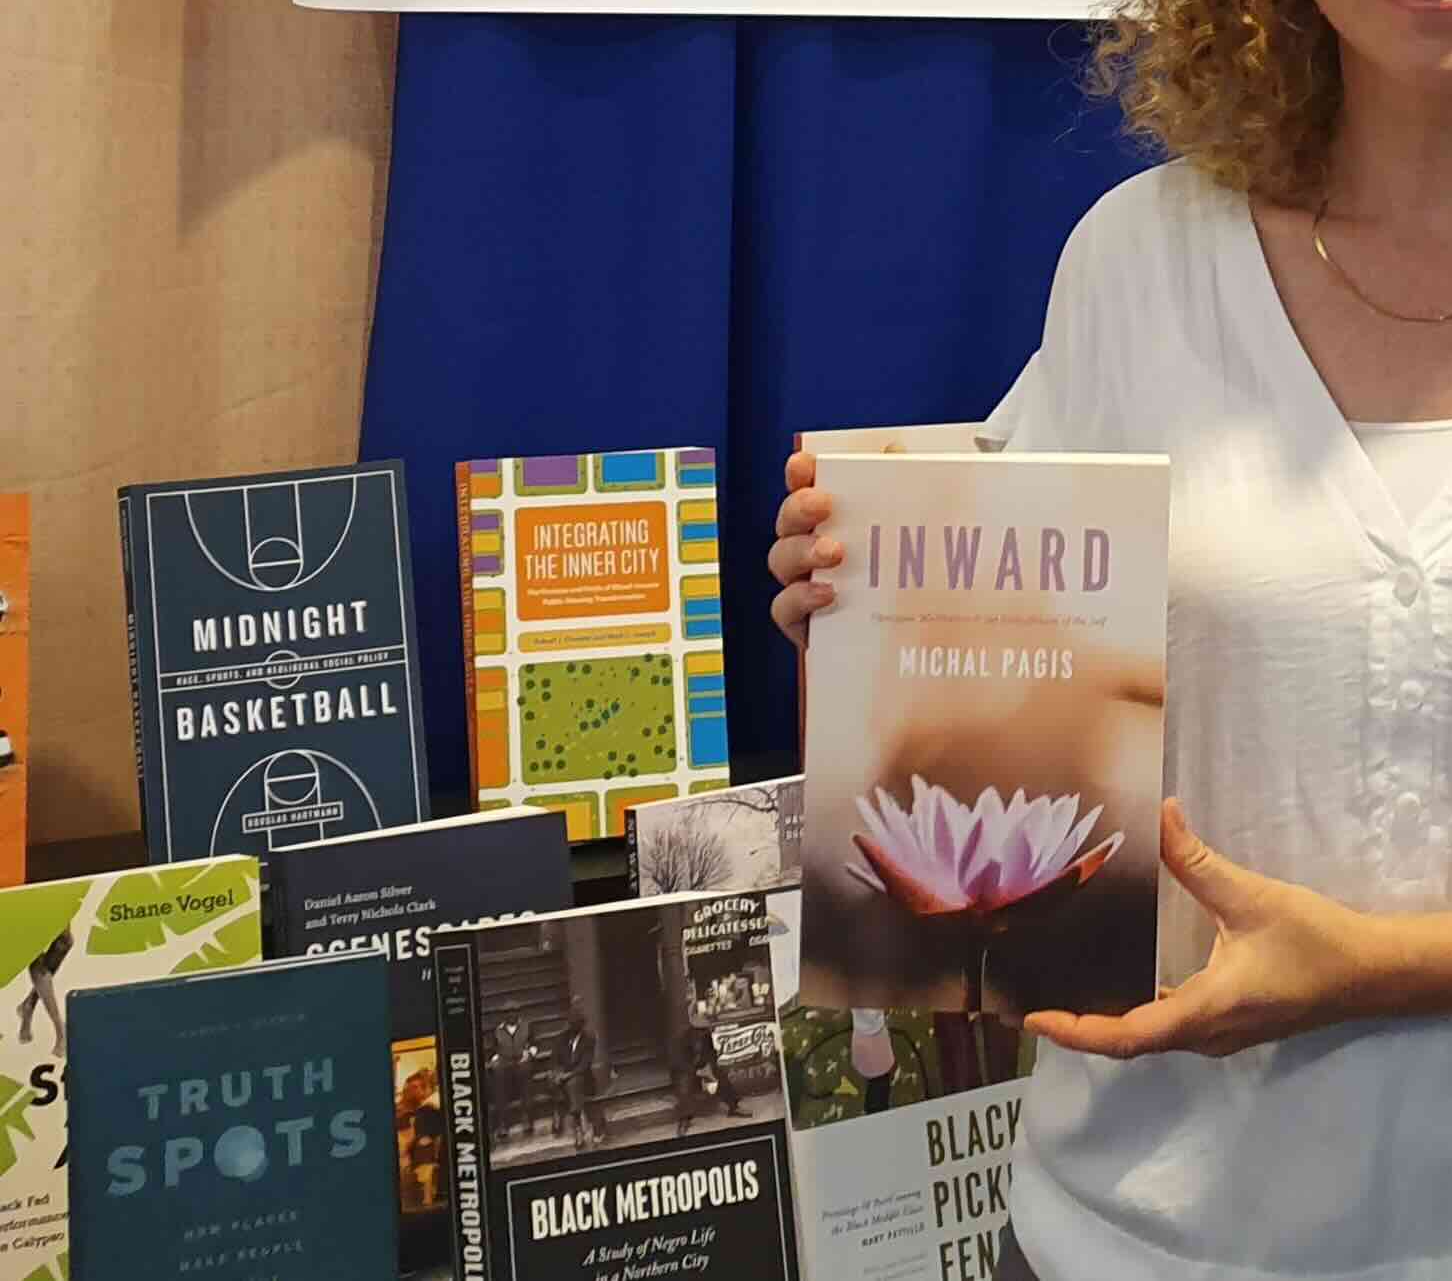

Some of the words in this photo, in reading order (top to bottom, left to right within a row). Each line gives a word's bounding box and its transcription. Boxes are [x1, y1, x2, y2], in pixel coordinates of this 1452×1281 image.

[534, 519, 649, 550] INTEGRATING
[525, 554, 558, 580] THE
[563, 550, 616, 578] INNER
[621, 548, 659, 574] CITY
[869, 525, 1110, 591] INWARD
[193, 601, 367, 652] MIDNIGHT
[900, 646, 991, 678] MICHAL
[1001, 648, 1073, 679] PAGIS
[177, 682, 397, 740] BASKETBALL
[110, 903, 172, 922] Shane
[176, 889, 234, 913] Vogel
[304, 894, 341, 911] Daniel
[381, 884, 412, 899] Silver
[306, 917, 327, 929] and
[330, 911, 359, 926] Terry
[361, 905, 405, 921] Nichols
[407, 899, 436, 913] Clark
[694, 897, 760, 923] GROCERY
[139, 1057, 334, 1119] TRUTH
[450, 1053, 475, 1134] BLACK
[105, 1109, 368, 1197] SPOTS
[531, 1186, 609, 1240] BLACK
[616, 1160, 760, 1224] METROPOLIS
[582, 1250, 595, 1266] A
[598, 1242, 634, 1264] Study
[636, 1237, 650, 1259] of
[652, 1232, 687, 1256] Negro
[691, 1226, 716, 1245] Life
[623, 1258, 678, 1281] Northern
[682, 1253, 709, 1272] City
